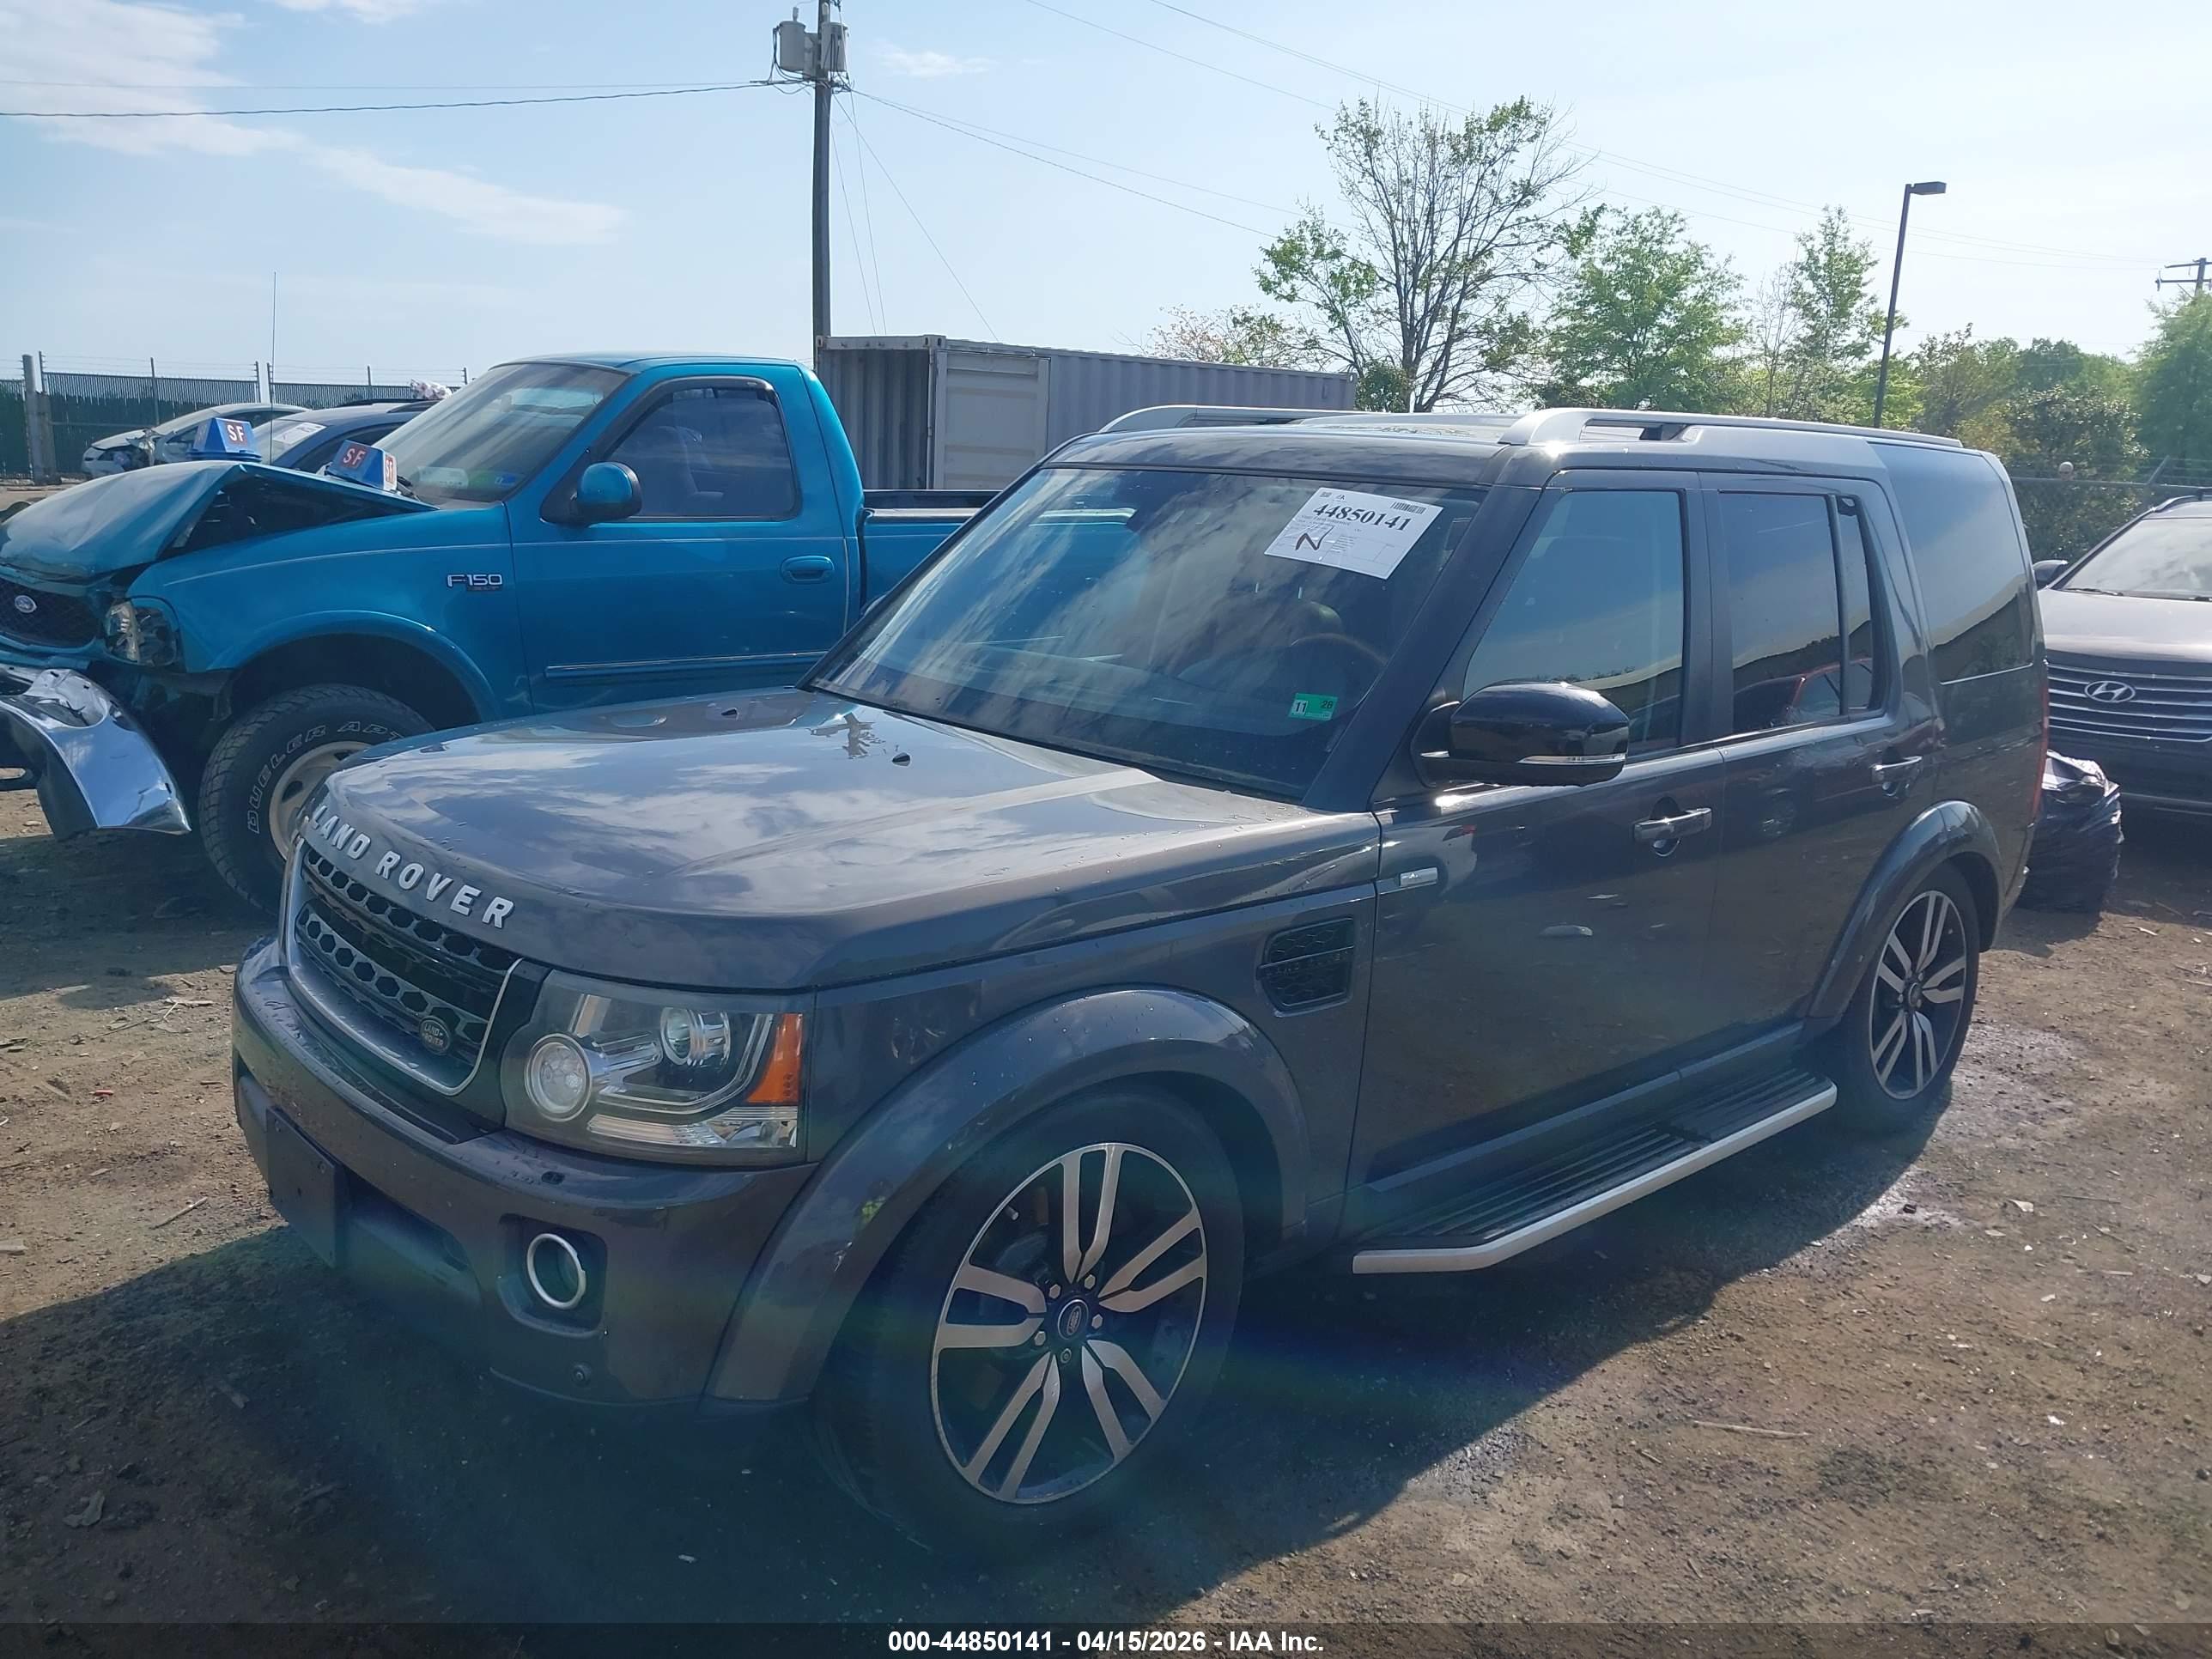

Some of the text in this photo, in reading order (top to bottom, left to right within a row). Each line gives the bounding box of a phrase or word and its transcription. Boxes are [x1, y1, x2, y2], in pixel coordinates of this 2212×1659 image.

[226, 423, 245, 443] SF
[343, 447, 367, 466] SF
[1313, 502, 1413, 532] 44850141
[1295, 702, 1308, 713] 11
[246, 724, 328, 835] DUELER
[311, 804, 515, 930] LAND ROVER
